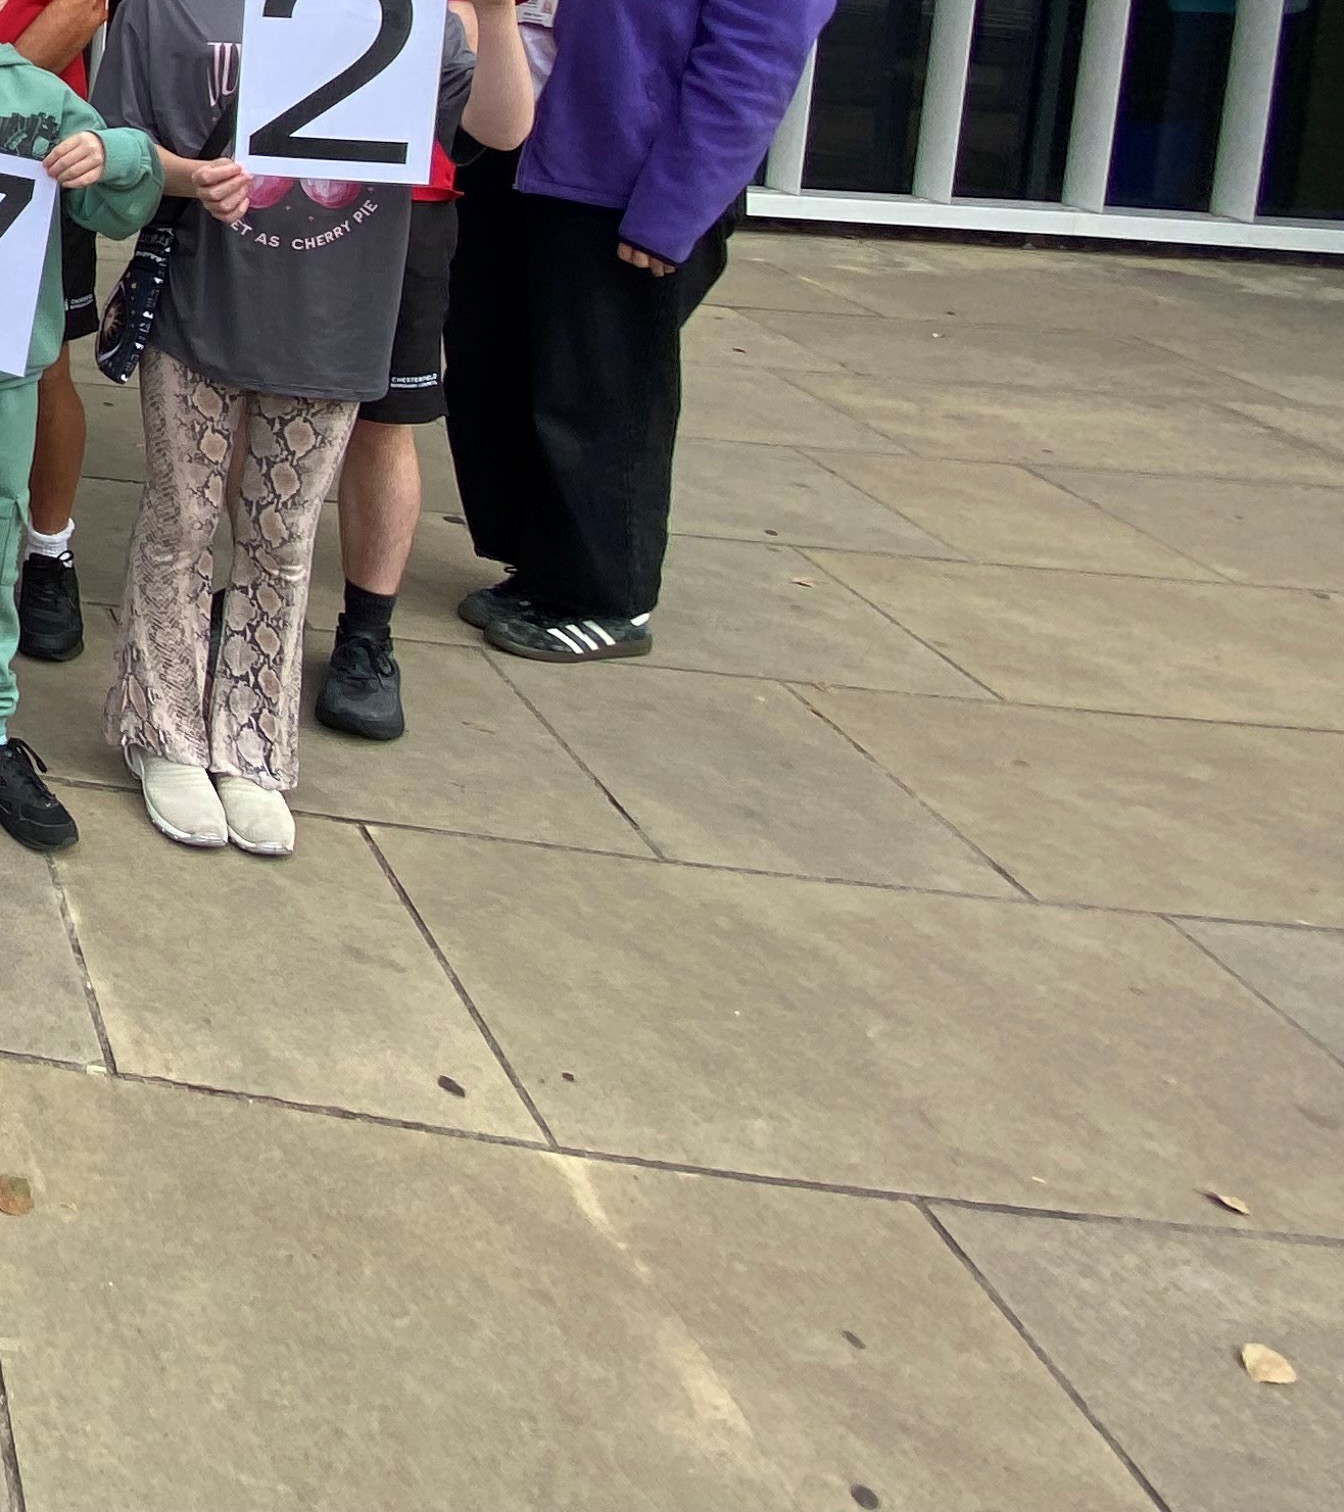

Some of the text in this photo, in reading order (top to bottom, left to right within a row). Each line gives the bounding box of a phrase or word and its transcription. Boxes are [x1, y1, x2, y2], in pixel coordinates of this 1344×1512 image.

[254, 233, 281, 248] AS
[291, 220, 352, 250] CHERRY
[352, 199, 379, 225] PIE
